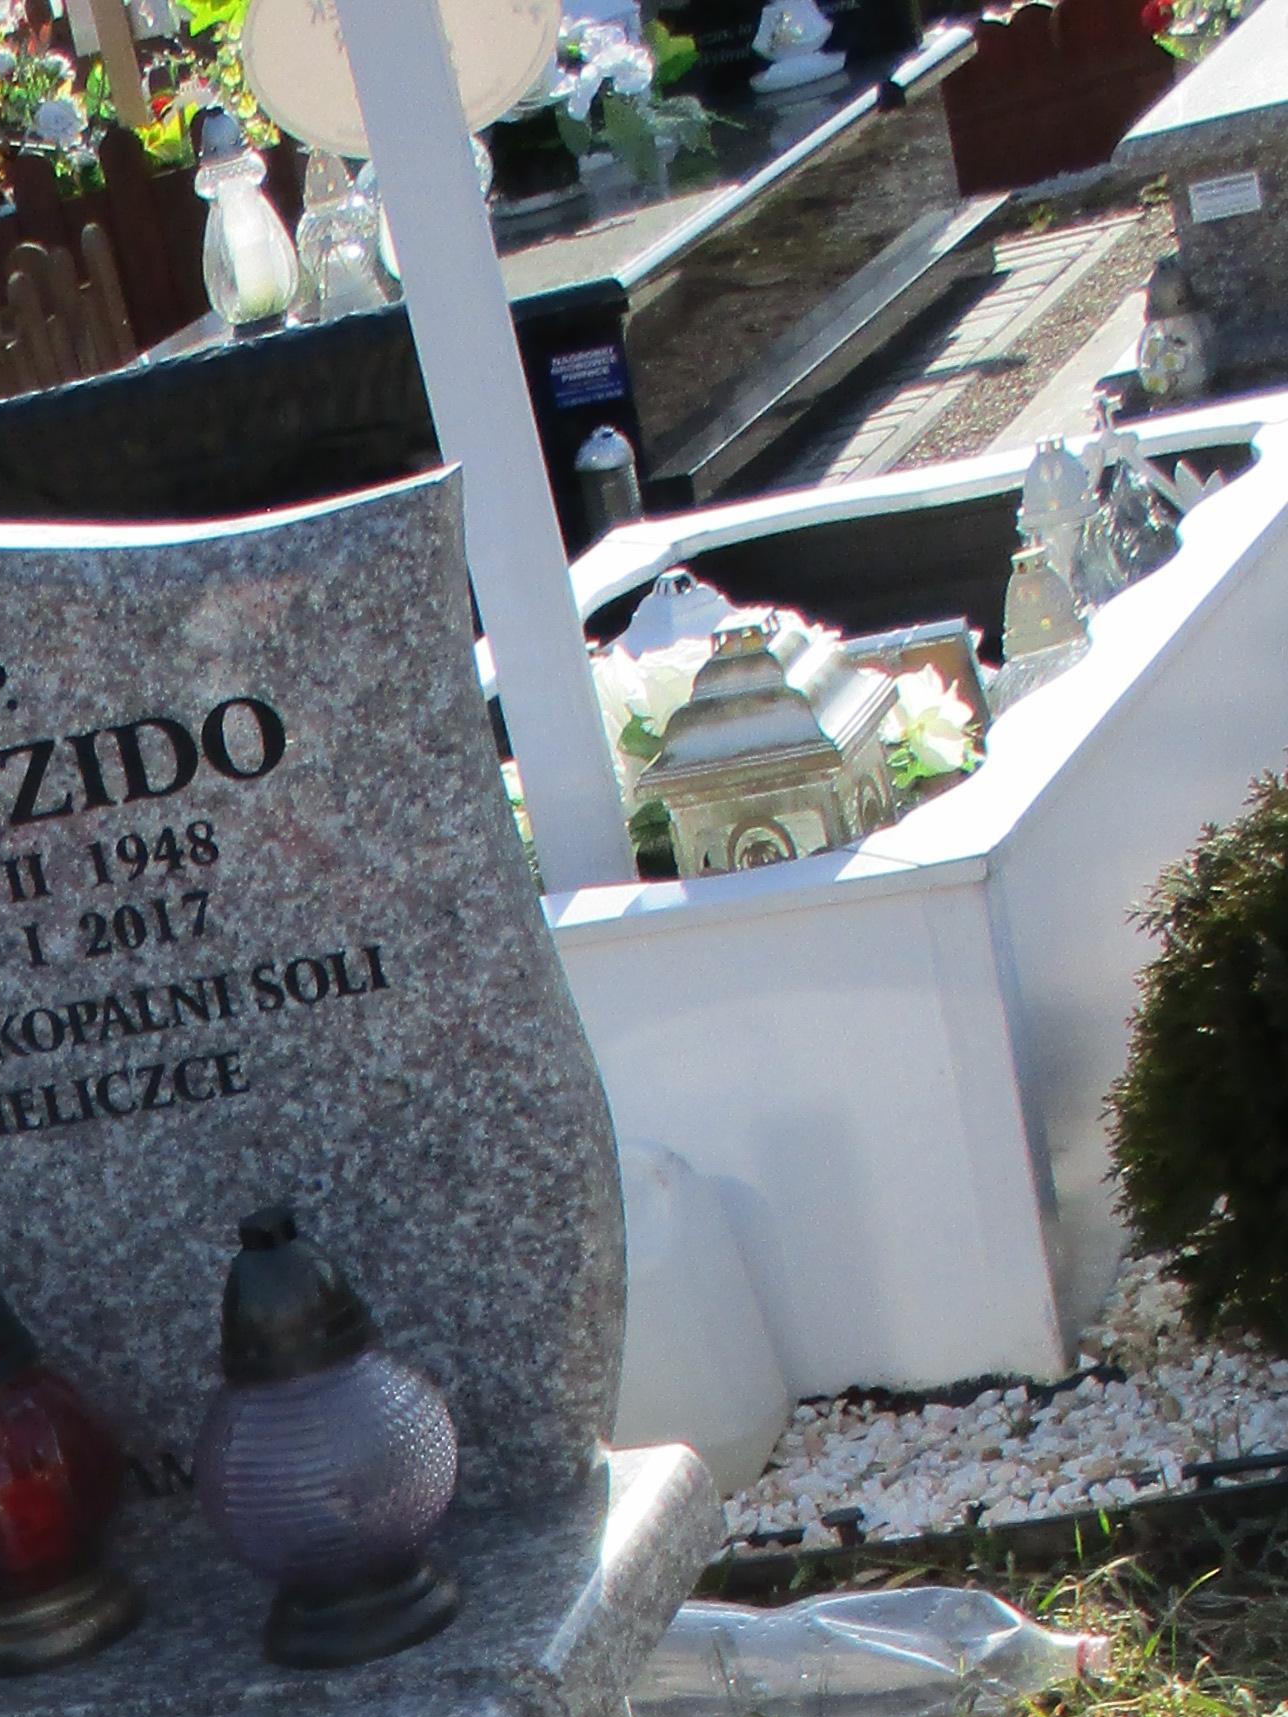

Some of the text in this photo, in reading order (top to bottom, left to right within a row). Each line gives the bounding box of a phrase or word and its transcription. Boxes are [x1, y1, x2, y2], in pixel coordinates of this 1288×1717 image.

[88, 819, 221, 890] 1948
[24, 923, 48, 969] I
[80, 889, 213, 957] 2017
[250, 943, 392, 1014] SOLI
